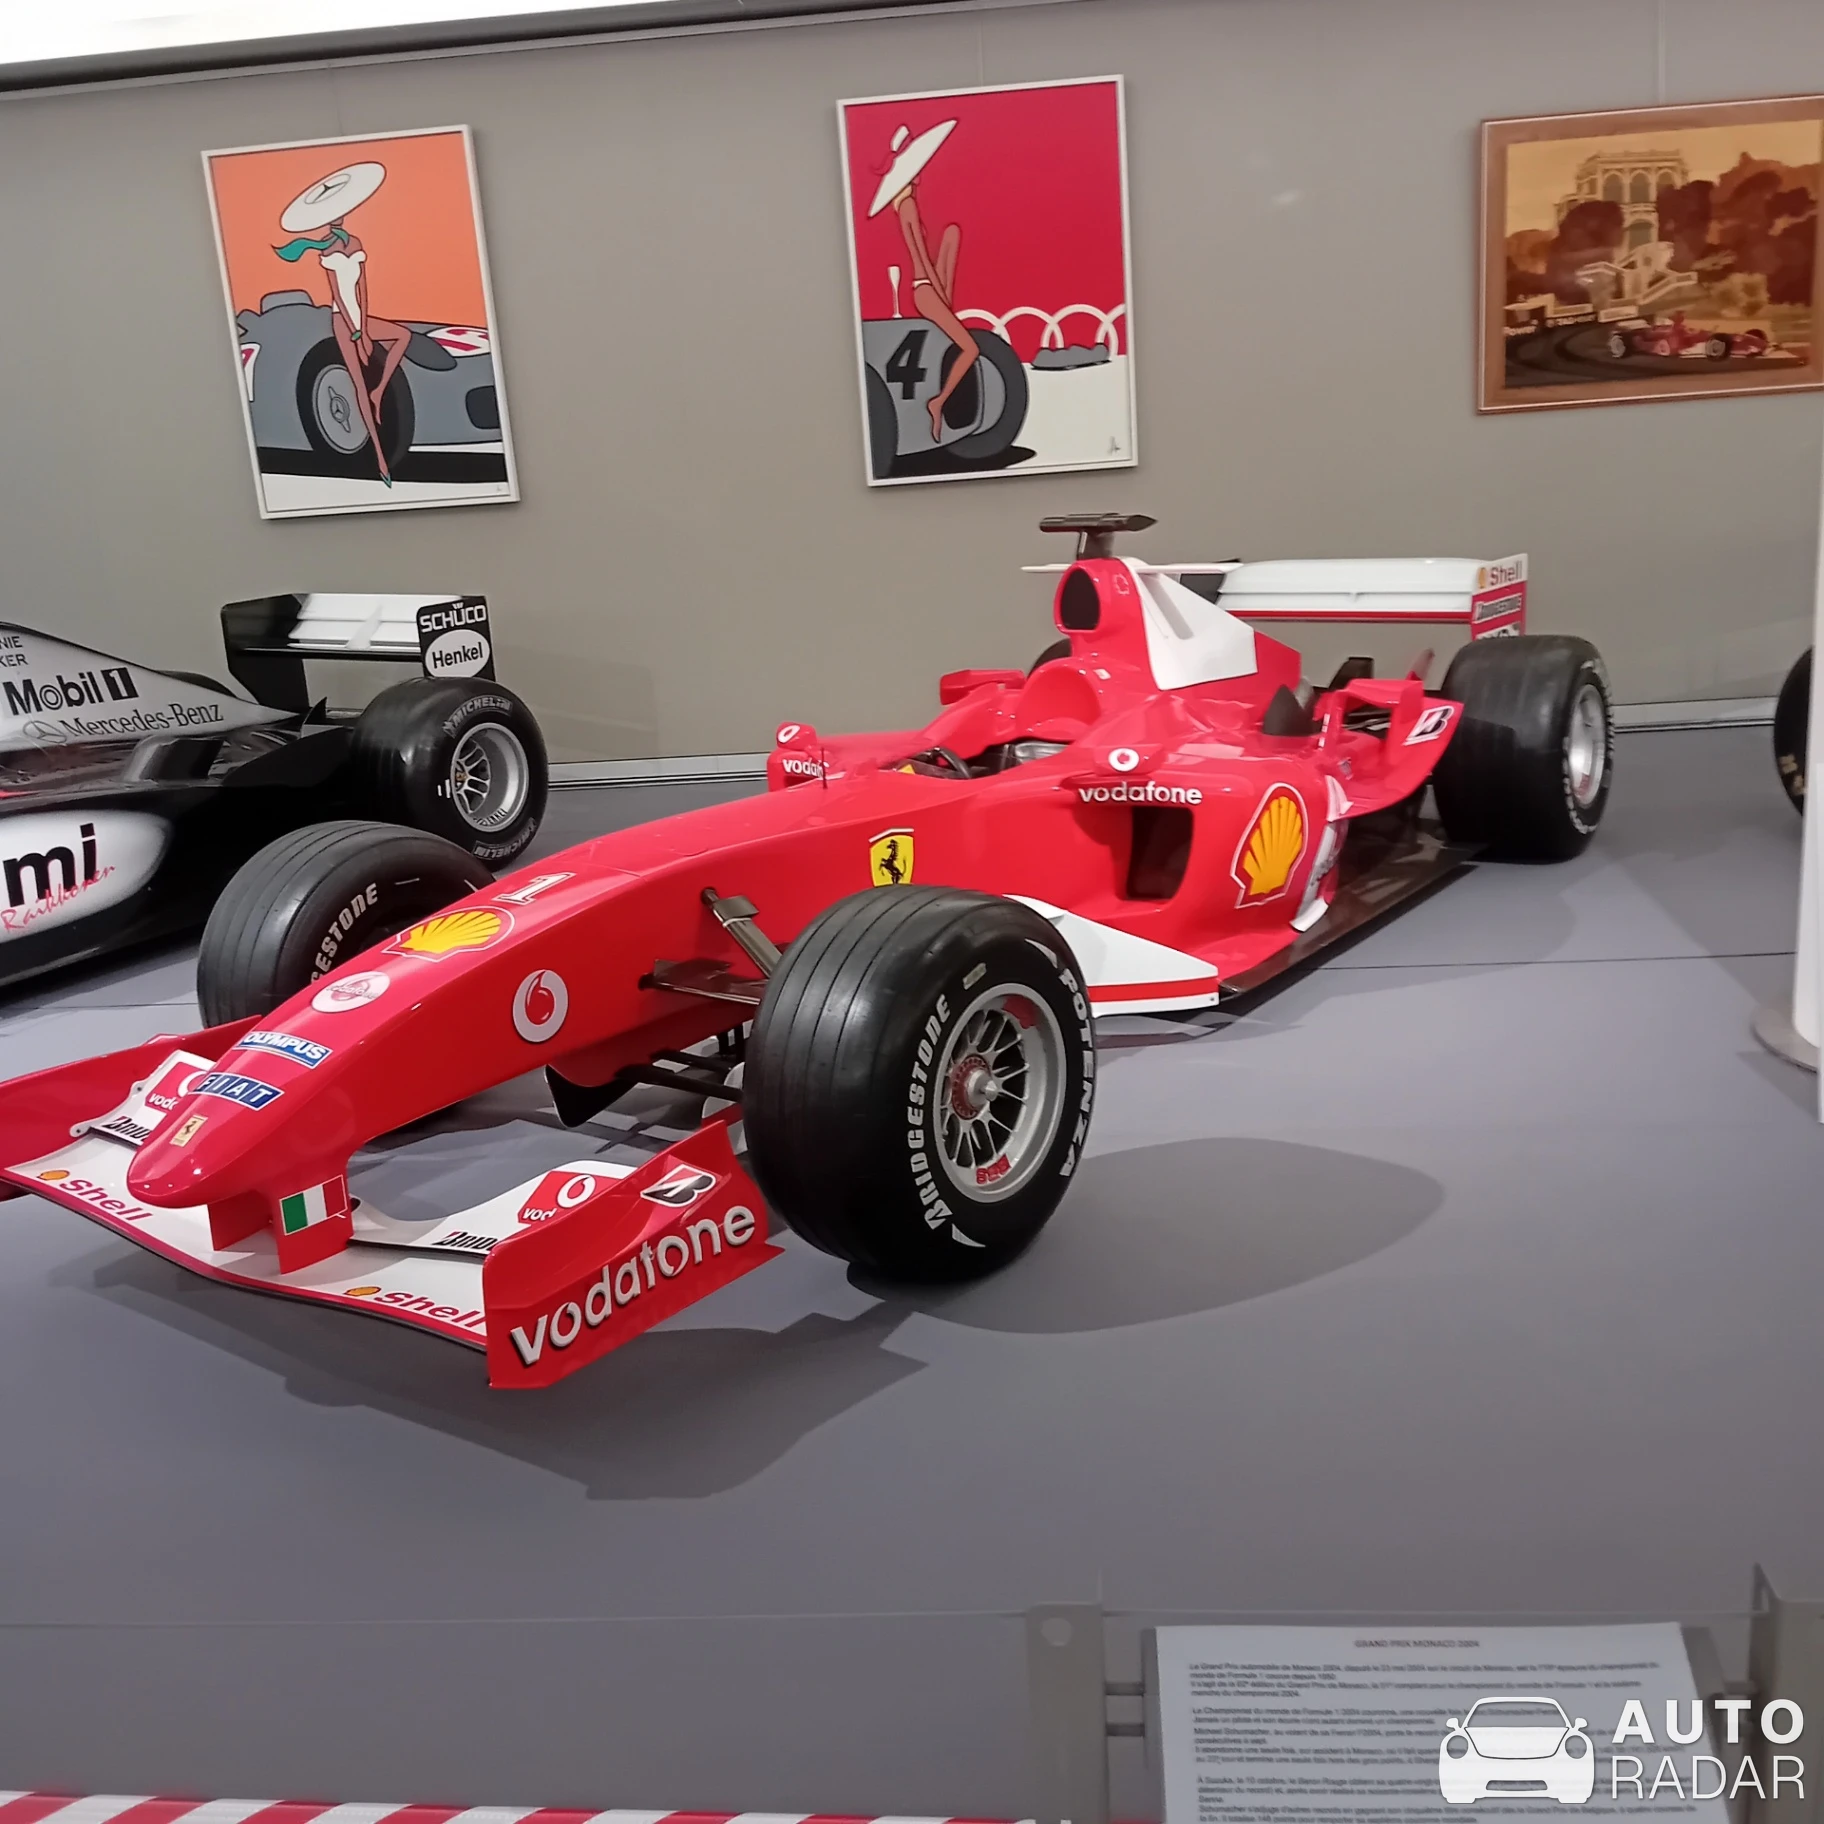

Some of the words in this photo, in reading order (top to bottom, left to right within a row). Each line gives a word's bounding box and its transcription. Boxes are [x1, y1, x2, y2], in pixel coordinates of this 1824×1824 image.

[886, 330, 929, 400] 4
[1490, 560, 1522, 586] Shell
[432, 642, 483, 669] Henkel
[2, 671, 104, 716] Mobil
[58, 703, 224, 737] Mercedes-Benz
[452, 697, 510, 728] MICHELIN
[1079, 781, 1203, 804] vodafone
[243, 1032, 326, 1060] OLYMPUS
[197, 1076, 273, 1103] FIAT
[1059, 968, 1094, 1177] POTENZA
[907, 994, 953, 1230] BRIDGESTONE
[59, 1179, 153, 1221] Shell
[510, 1205, 755, 1366] vodafone
[374, 1292, 486, 1328] Shell
